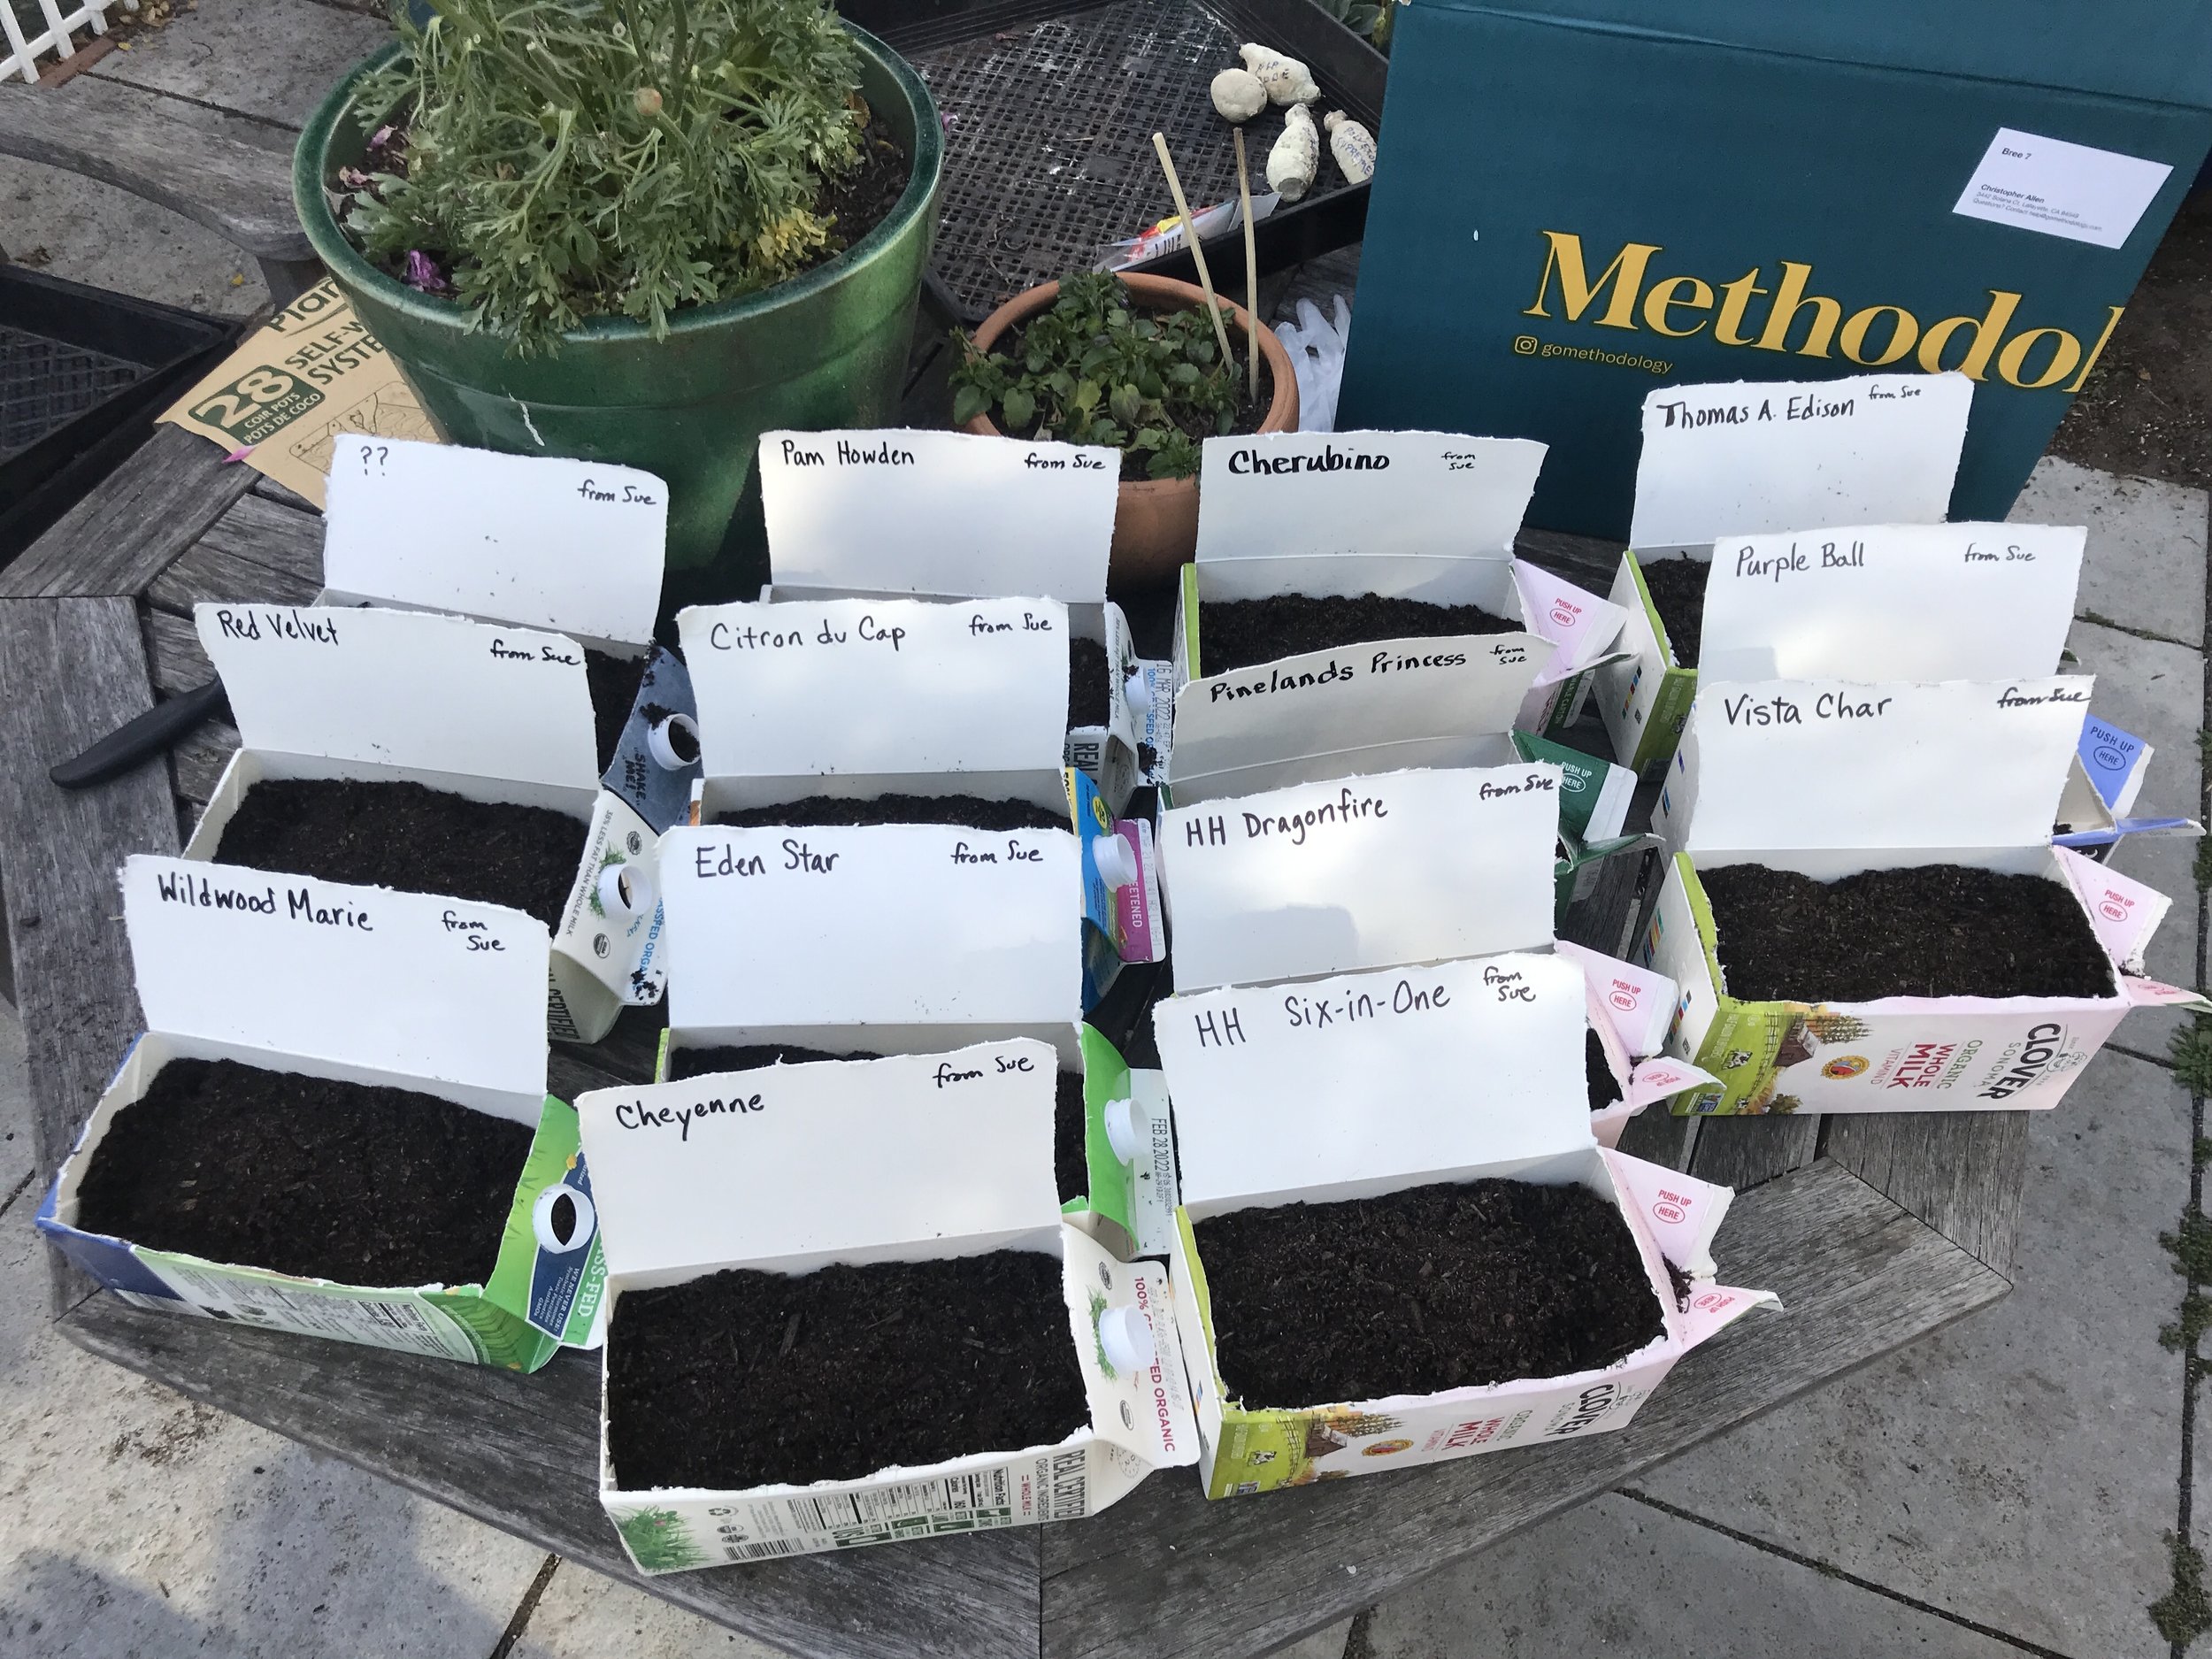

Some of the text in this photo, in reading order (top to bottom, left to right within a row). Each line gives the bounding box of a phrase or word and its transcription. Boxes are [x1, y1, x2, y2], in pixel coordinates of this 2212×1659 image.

[2001, 147, 2024, 160] Bree
[1980, 183, 2046, 204] Christopher Allen
[1541, 342, 1673, 374] gomethodology
[194, 370, 294, 429] 28
[1868, 384, 1922, 402] from Sue
[243, 393, 321, 444] POTS DE COCO
[244, 392, 300, 430] COIR POTS
[1656, 400, 1750, 430] Thomas
[1786, 396, 1855, 423] Edison
[359, 445, 389, 477] ??
[781, 439, 916, 468] Pam Howden
[1025, 452, 1107, 471] from Sue
[1228, 444, 1391, 476] Cherubino
[1440, 450, 1478, 464] from
[577, 479, 657, 506] from Sue
[1735, 541, 1865, 584] Purple Ball
[1964, 542, 2037, 565] from Sue
[1554, 611, 1573, 626] HERE
[1555, 596, 1583, 615] PUSH UP
[216, 609, 340, 648] Red Velvet
[710, 615, 908, 652] Citron du Cap
[968, 612, 1053, 637] from Sue
[489, 638, 582, 665] from Sue
[1488, 644, 1525, 657] from
[1156, 663, 1171, 674] 16
[1210, 650, 1467, 704] Pinelands Princess
[1156, 679, 1171, 693] MAR
[1996, 686, 2047, 710] from
[1156, 696, 1171, 721] 2022
[1724, 690, 1893, 727] Vista Char
[2090, 725, 2135, 755] PUSH UP
[2098, 749, 2120, 765] HERE
[625, 758, 637, 791] ME!
[634, 752, 647, 801] SHAKE
[1563, 776, 1582, 789] HERE
[1580, 768, 1593, 779] UP
[1479, 772, 1555, 803] from Sue
[1186, 787, 1389, 848] HH Dragonfire
[595, 826, 609, 846] LESS
[592, 845, 601, 863] FAT
[695, 838, 841, 879] Eden Star
[949, 840, 1045, 865] from Sue
[583, 862, 595, 885] THAN
[157, 871, 375, 933] Wildwood Marie
[572, 885, 588, 917] WHOLE
[2103, 904, 2124, 920] HERE
[2105, 888, 2136, 909] PUSH UP
[442, 910, 488, 933] from
[565, 915, 578, 938] MILK
[465, 934, 506, 953] Sue
[1482, 965, 1524, 986] from
[1612, 979, 1641, 995] PUSH UP
[1497, 983, 1538, 1002] Sue
[1613, 995, 1632, 1008] HERE
[1194, 979, 1451, 1048] HH Six-in-One
[932, 1053, 1036, 1089] from Sue
[1886, 1043, 1938, 1089] MILK
[1912, 1043, 1958, 1087] WHOLE
[1936, 1039, 1983, 1089] ORGANIC
[1976, 1023, 2062, 1100] CLOVER
[1978, 1041, 2022, 1087] SONOMA
[616, 1092, 765, 1141] Cheyenne
[1151, 1118, 1168, 1135] FEB
[1152, 1137, 1169, 1148] 28
[1153, 1148, 1170, 1172] 2022
[1657, 1189, 1692, 1207] PUSH UP
[1657, 1206, 1681, 1221] HERE
[571, 1267, 580, 1282] WE
[560, 1281, 575, 1312] NEVER
[1134, 1275, 1148, 1310] 100%
[534, 1296, 544, 1317] GMOs
[1155, 1387, 1176, 1454] ORGANIC
[1544, 1383, 1616, 1437] CLOVER
[1440, 1419, 1484, 1451] MILK
[1469, 1416, 1506, 1446] WHOLE
[1035, 1457, 1049, 1490] ORGANIC
[1053, 1448, 1087, 1519] REAL CERTIFIED
